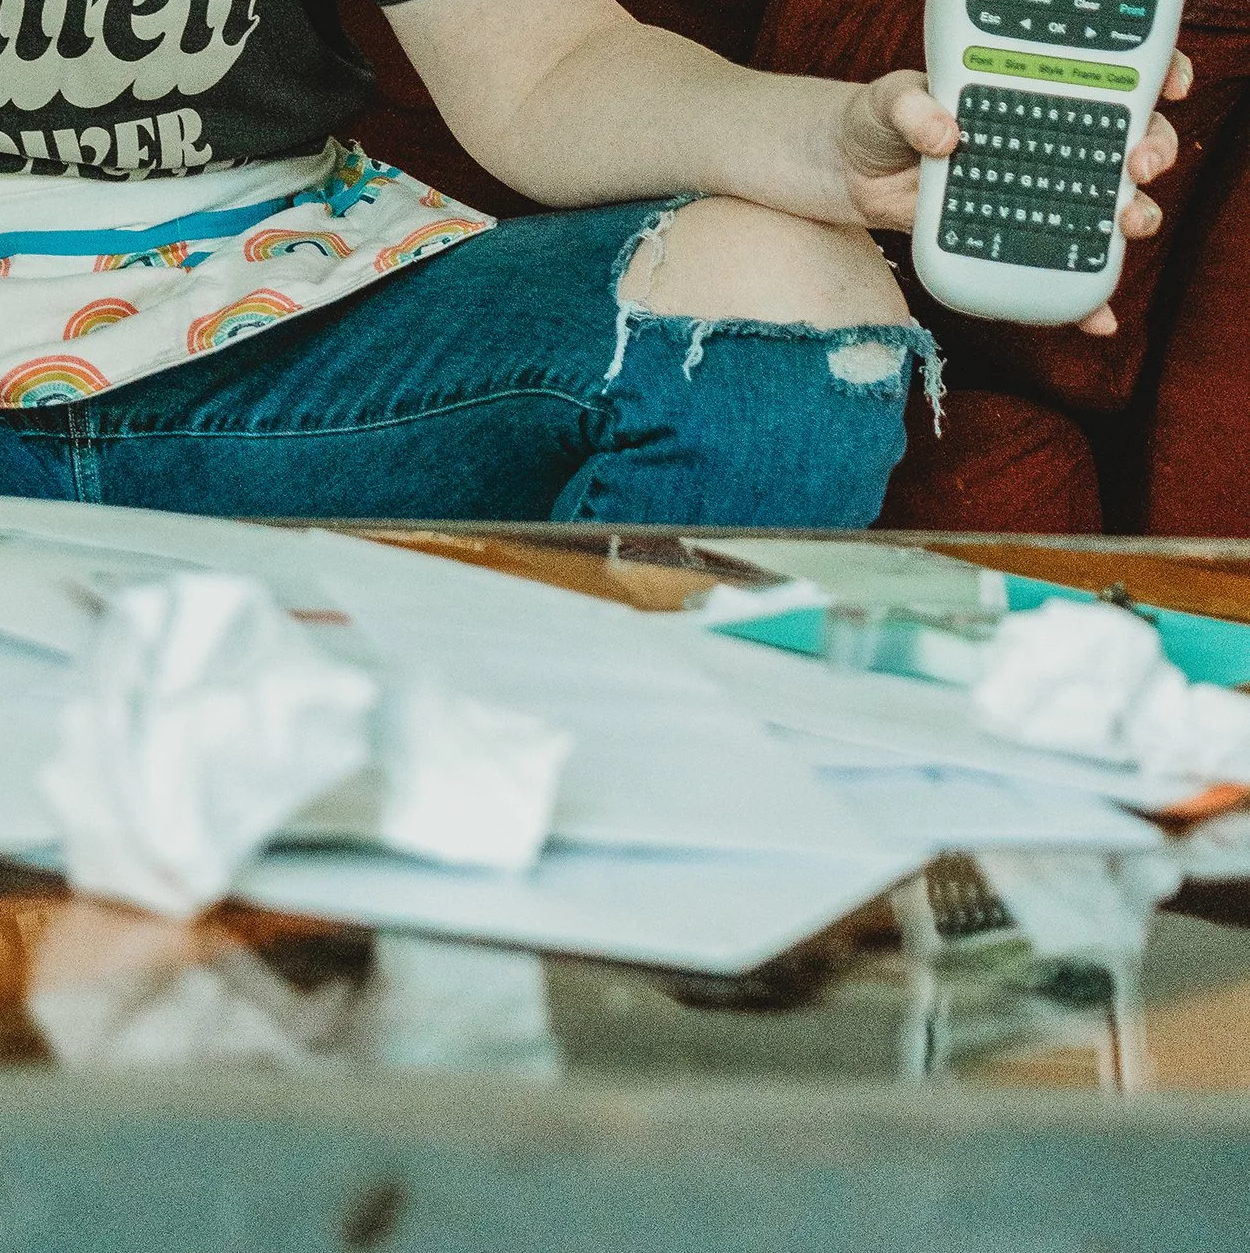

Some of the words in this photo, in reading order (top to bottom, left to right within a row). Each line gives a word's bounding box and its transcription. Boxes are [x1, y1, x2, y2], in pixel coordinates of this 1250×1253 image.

[1119, 3, 1146, 17] Print
[1048, 22, 1067, 35] OK
[969, 53, 993, 66] Font
[1005, 59, 1027, 71] Size
[1038, 63, 1064, 76] Style
[1072, 67, 1100, 81] Frame
